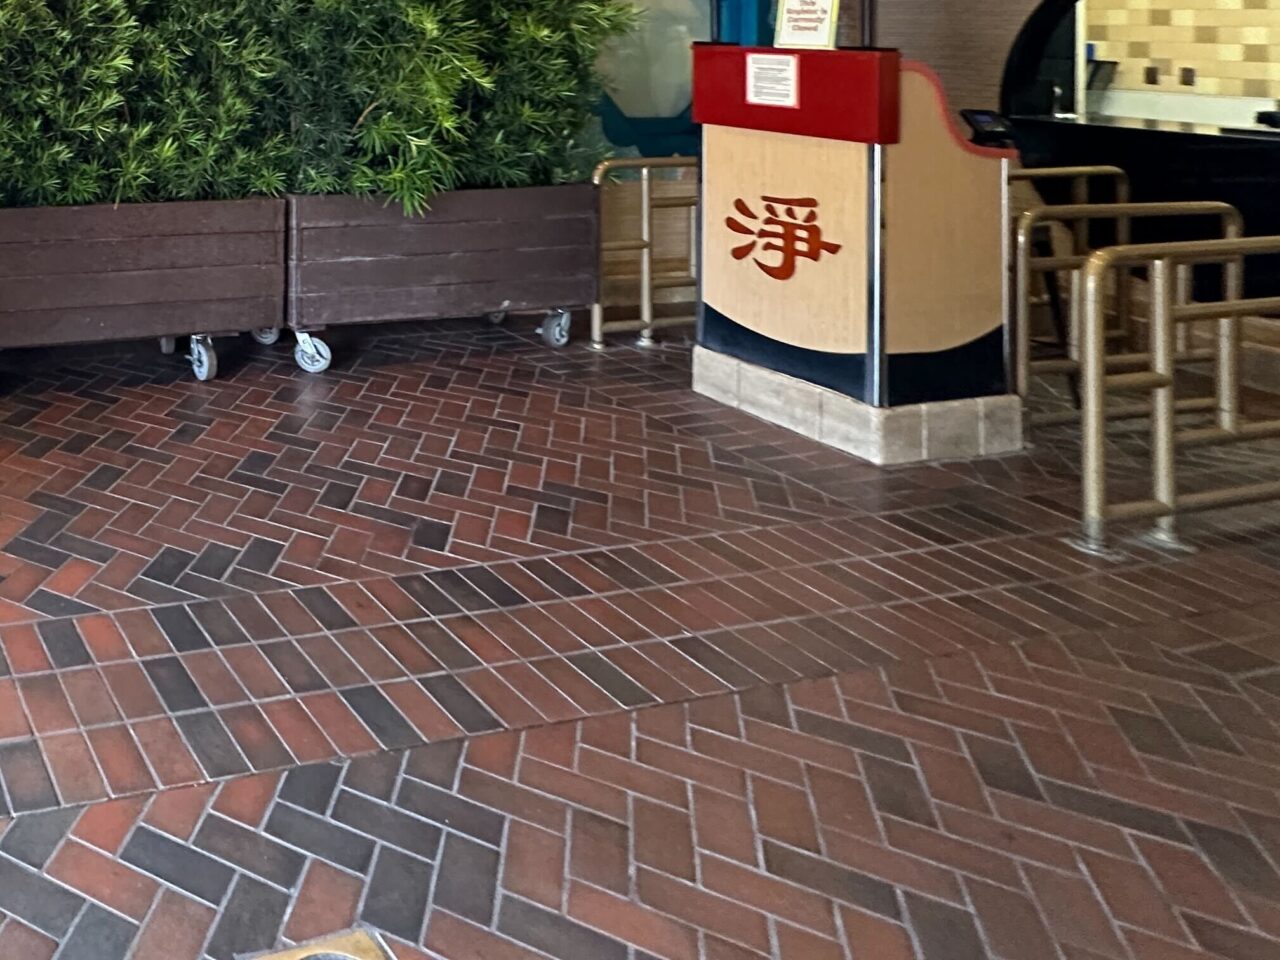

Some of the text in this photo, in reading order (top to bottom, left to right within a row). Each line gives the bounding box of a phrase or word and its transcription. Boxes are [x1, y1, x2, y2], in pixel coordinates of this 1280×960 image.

[799, 0, 816, 7] This
[786, 7, 818, 15] Register
[787, 16, 825, 24] Currently
[791, 24, 818, 32] Closed
